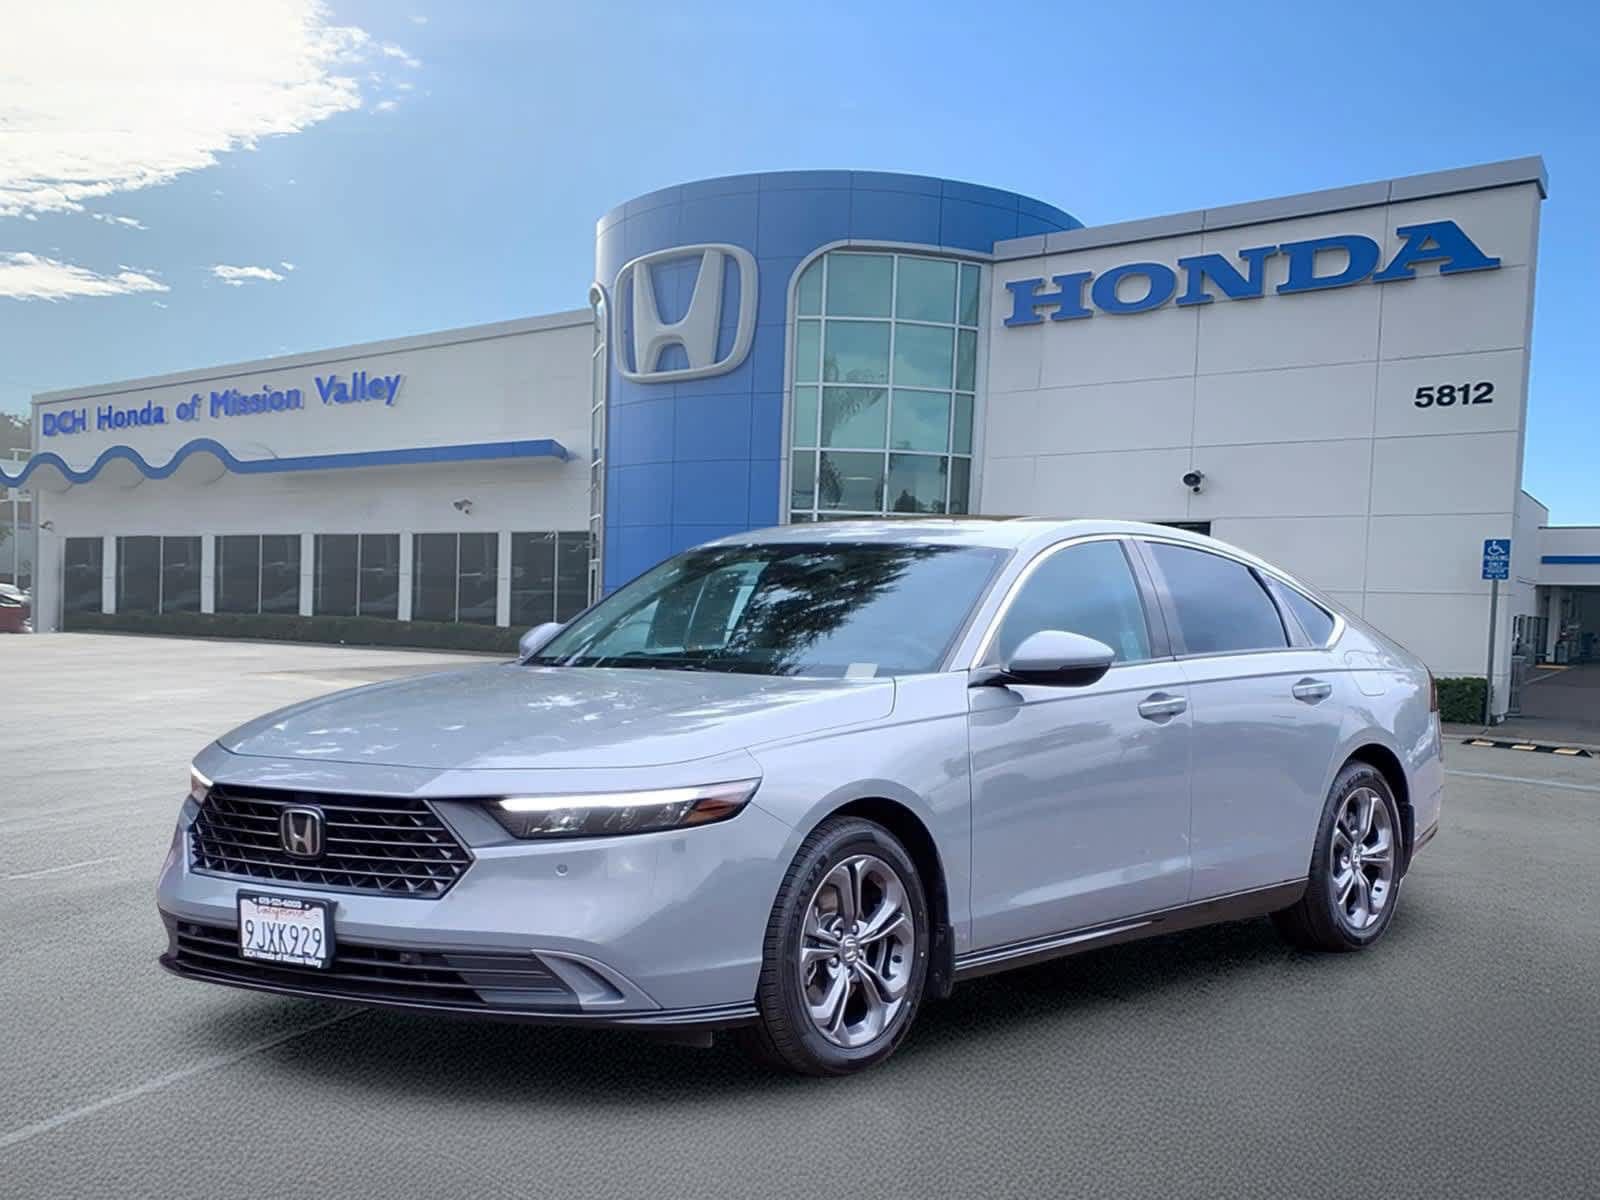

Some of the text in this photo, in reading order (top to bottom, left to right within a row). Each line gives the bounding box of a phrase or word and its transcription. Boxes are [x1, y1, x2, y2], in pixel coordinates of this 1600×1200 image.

[1003, 219, 1502, 328] HONDA
[42, 371, 404, 437] DCH Honda of Mission Valley
[1413, 381, 1495, 409] 5812
[245, 919, 323, 958] 9JXK929
